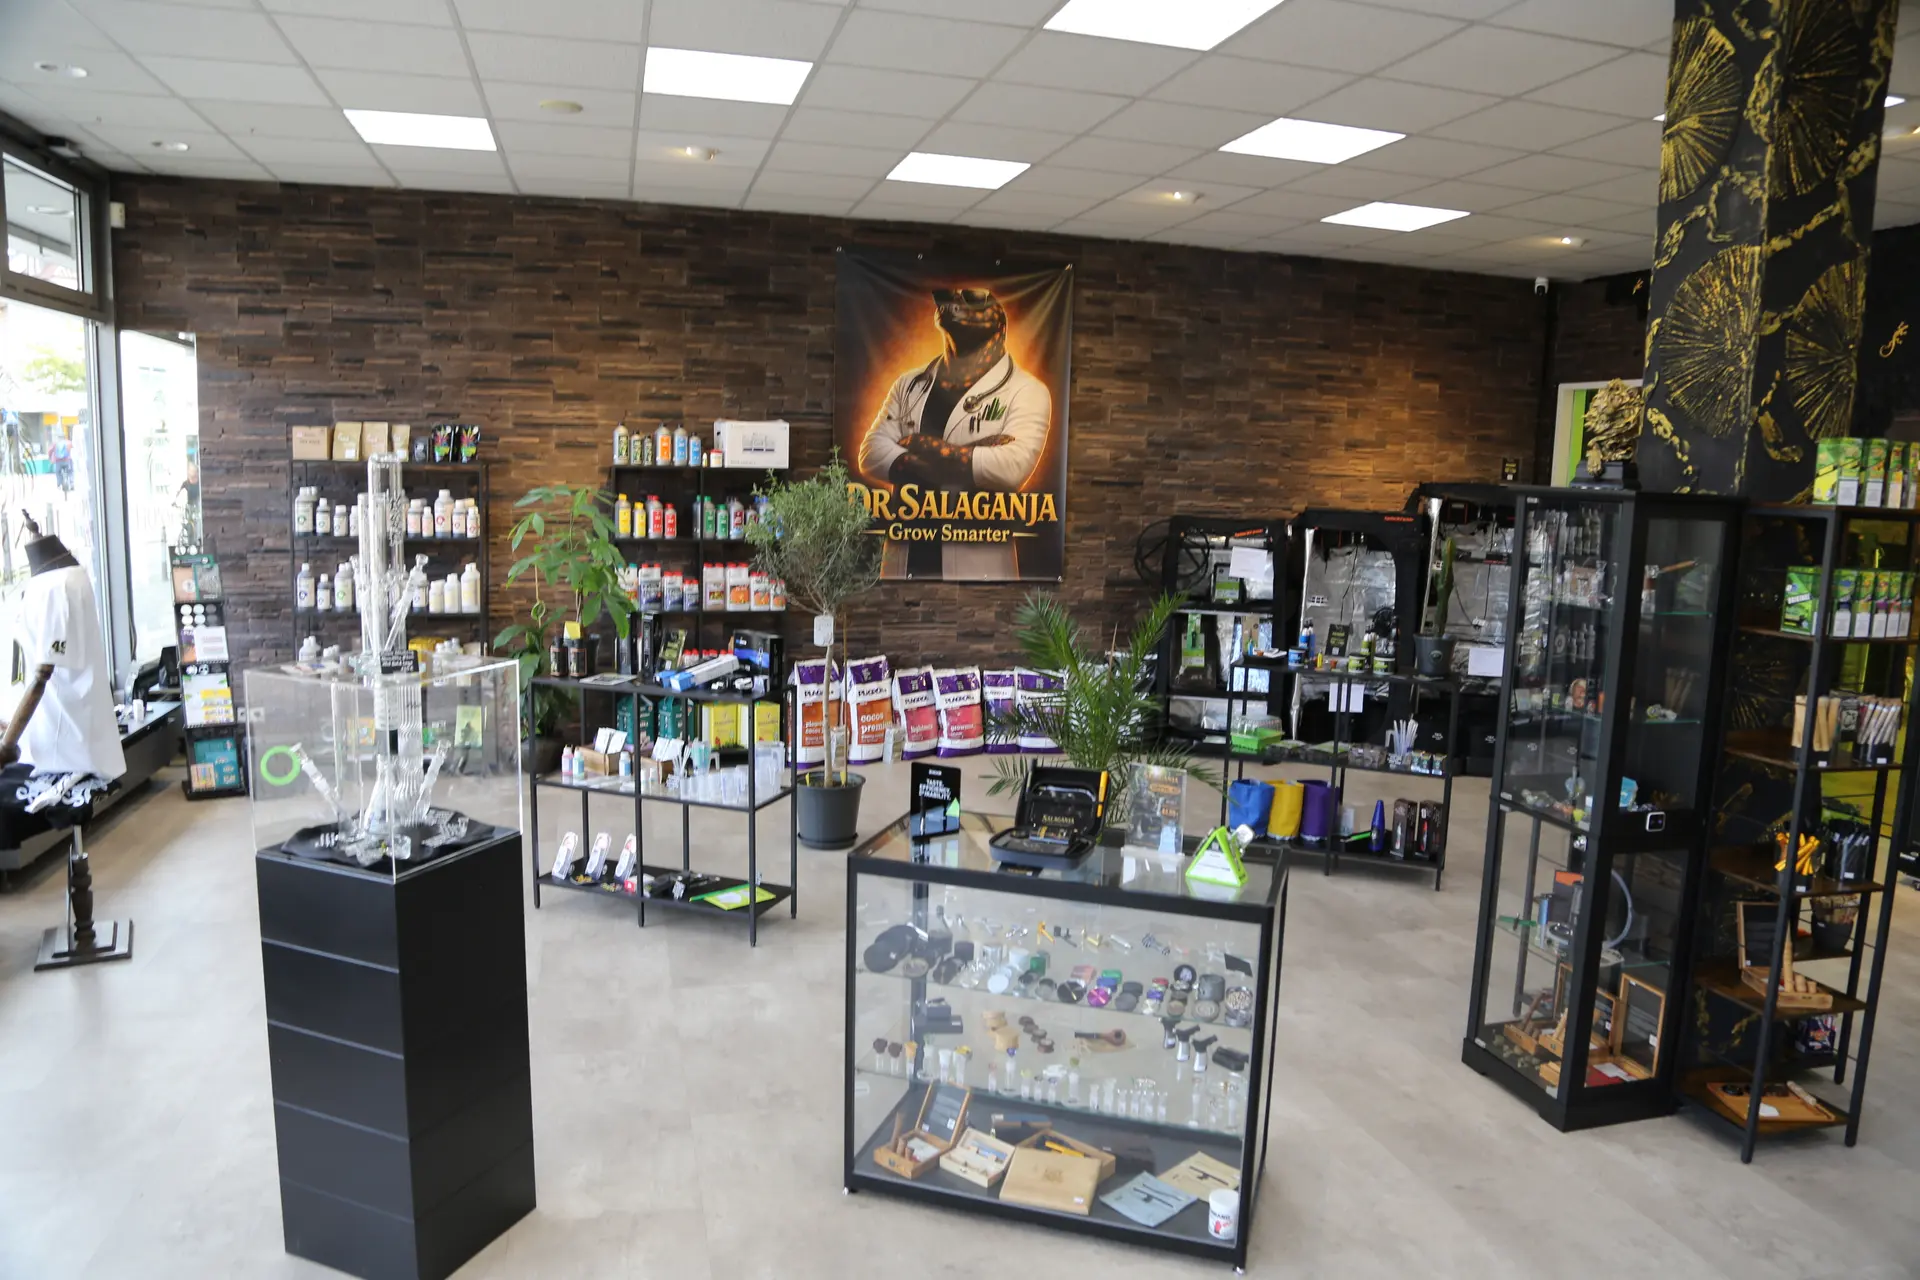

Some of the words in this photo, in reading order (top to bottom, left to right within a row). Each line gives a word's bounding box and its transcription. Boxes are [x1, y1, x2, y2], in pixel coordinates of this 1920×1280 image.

[898, 484, 1058, 526] SALAGANJA
[888, 522, 938, 541] Grow
[941, 523, 1010, 542] Smarter
